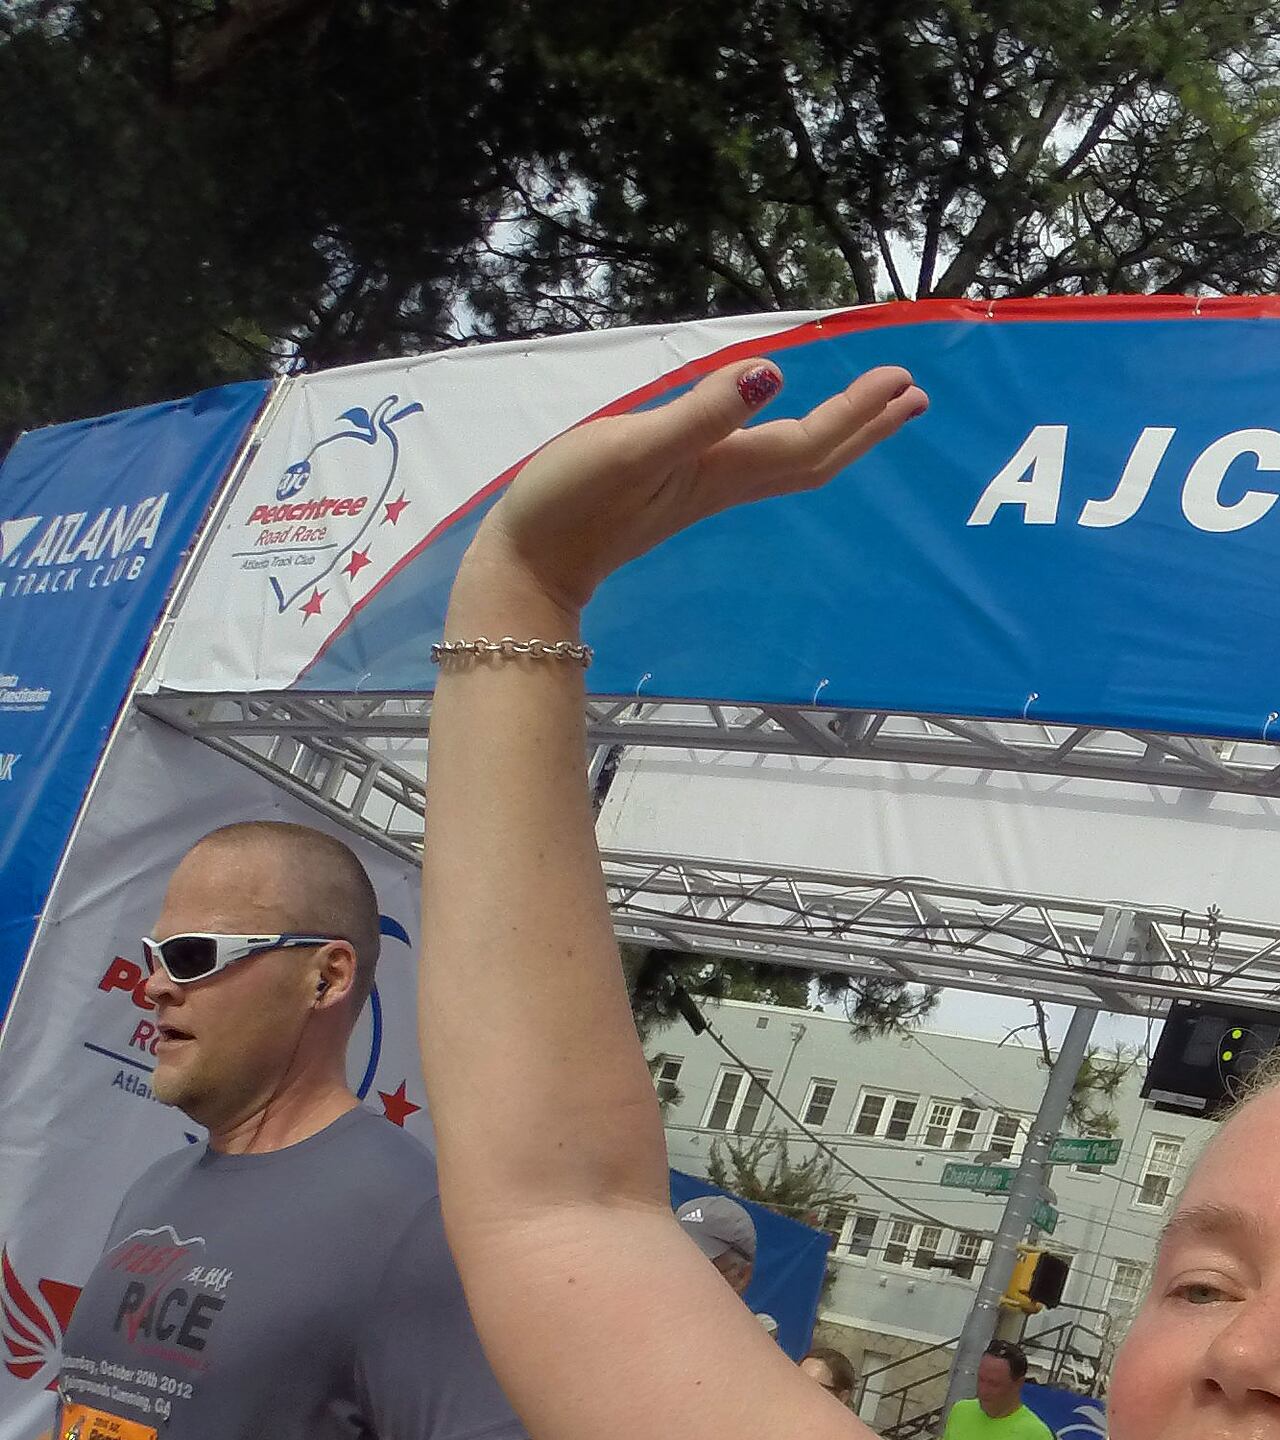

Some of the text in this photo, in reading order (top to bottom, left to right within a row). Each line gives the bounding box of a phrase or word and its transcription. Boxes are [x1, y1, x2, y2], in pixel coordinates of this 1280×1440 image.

[245, 496, 369, 527] Peachtree
[22, 491, 170, 569] ATLANTA
[253, 524, 328, 547] Road Race
[11, 555, 146, 597] TRACK CLUB
[112, 1069, 157, 1102] Atla
[113, 1280, 226, 1351] PACE
[160, 1375, 194, 1399] 2012
